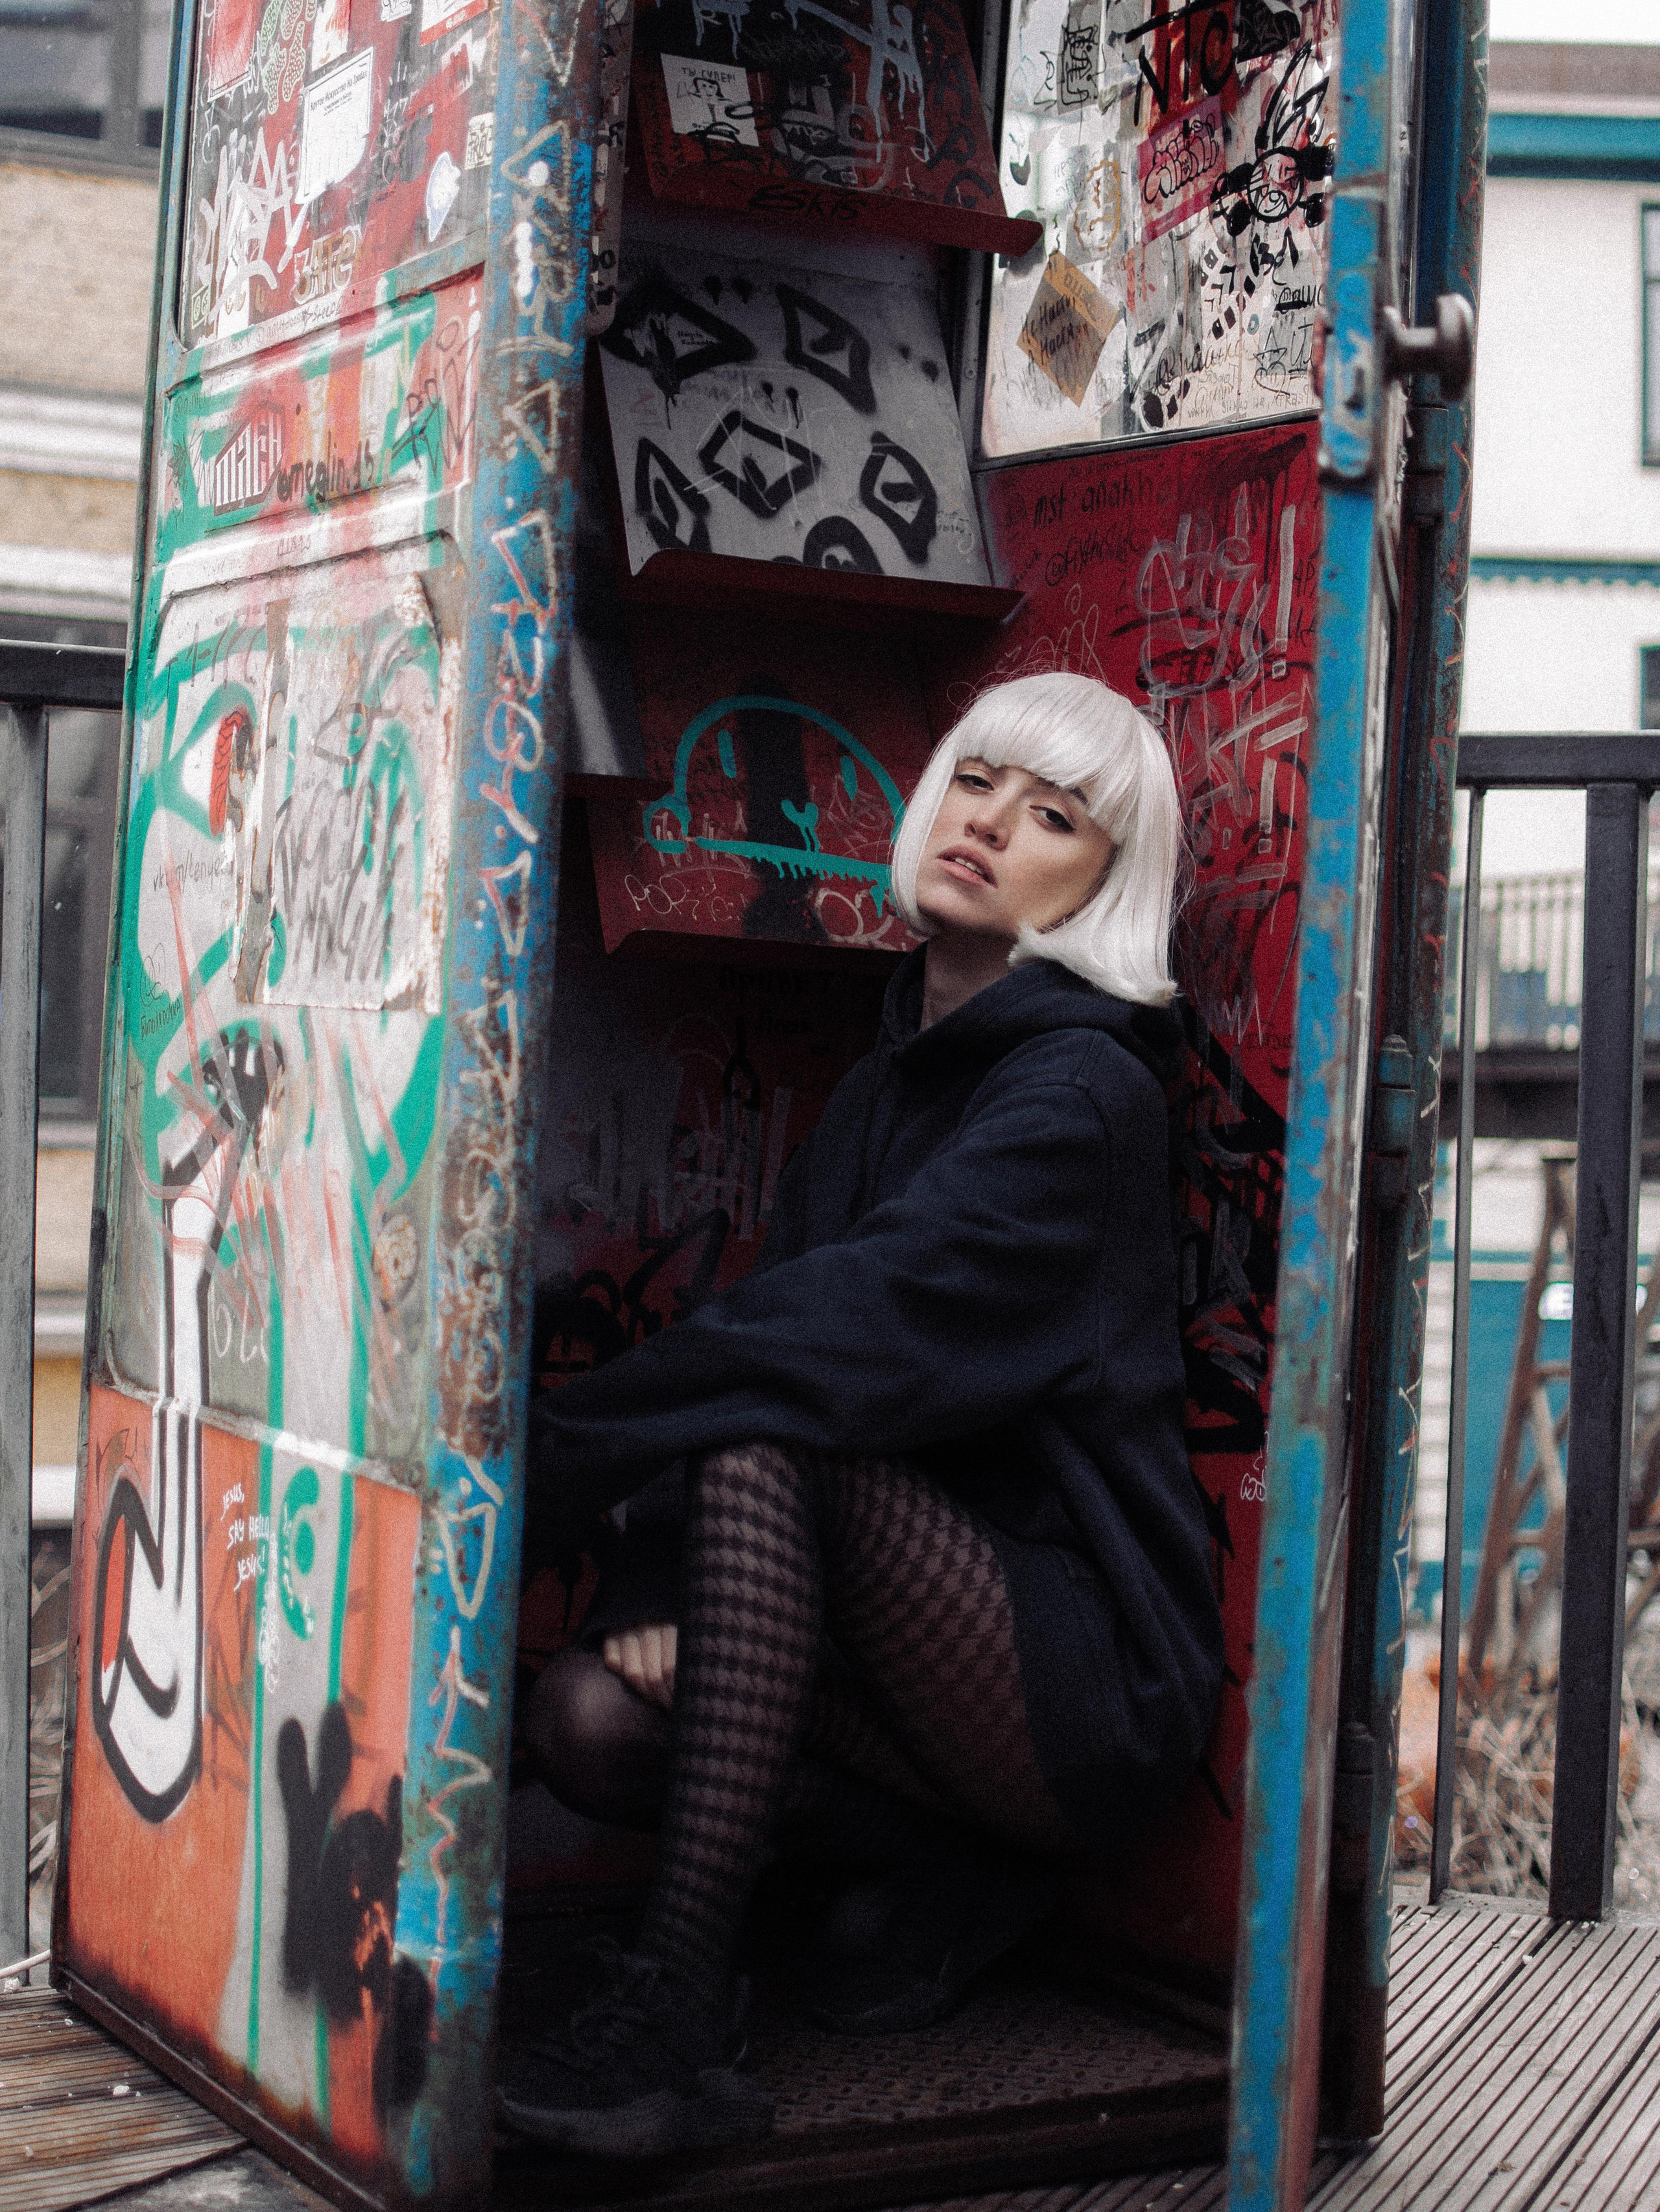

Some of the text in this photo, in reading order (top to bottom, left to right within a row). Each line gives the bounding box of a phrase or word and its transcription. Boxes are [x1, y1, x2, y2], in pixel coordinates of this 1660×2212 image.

[220, 1482, 244, 1522] JESUS,
[227, 1514, 270, 1550] SAY HELLO
[233, 1544, 266, 1592] JESUS!
